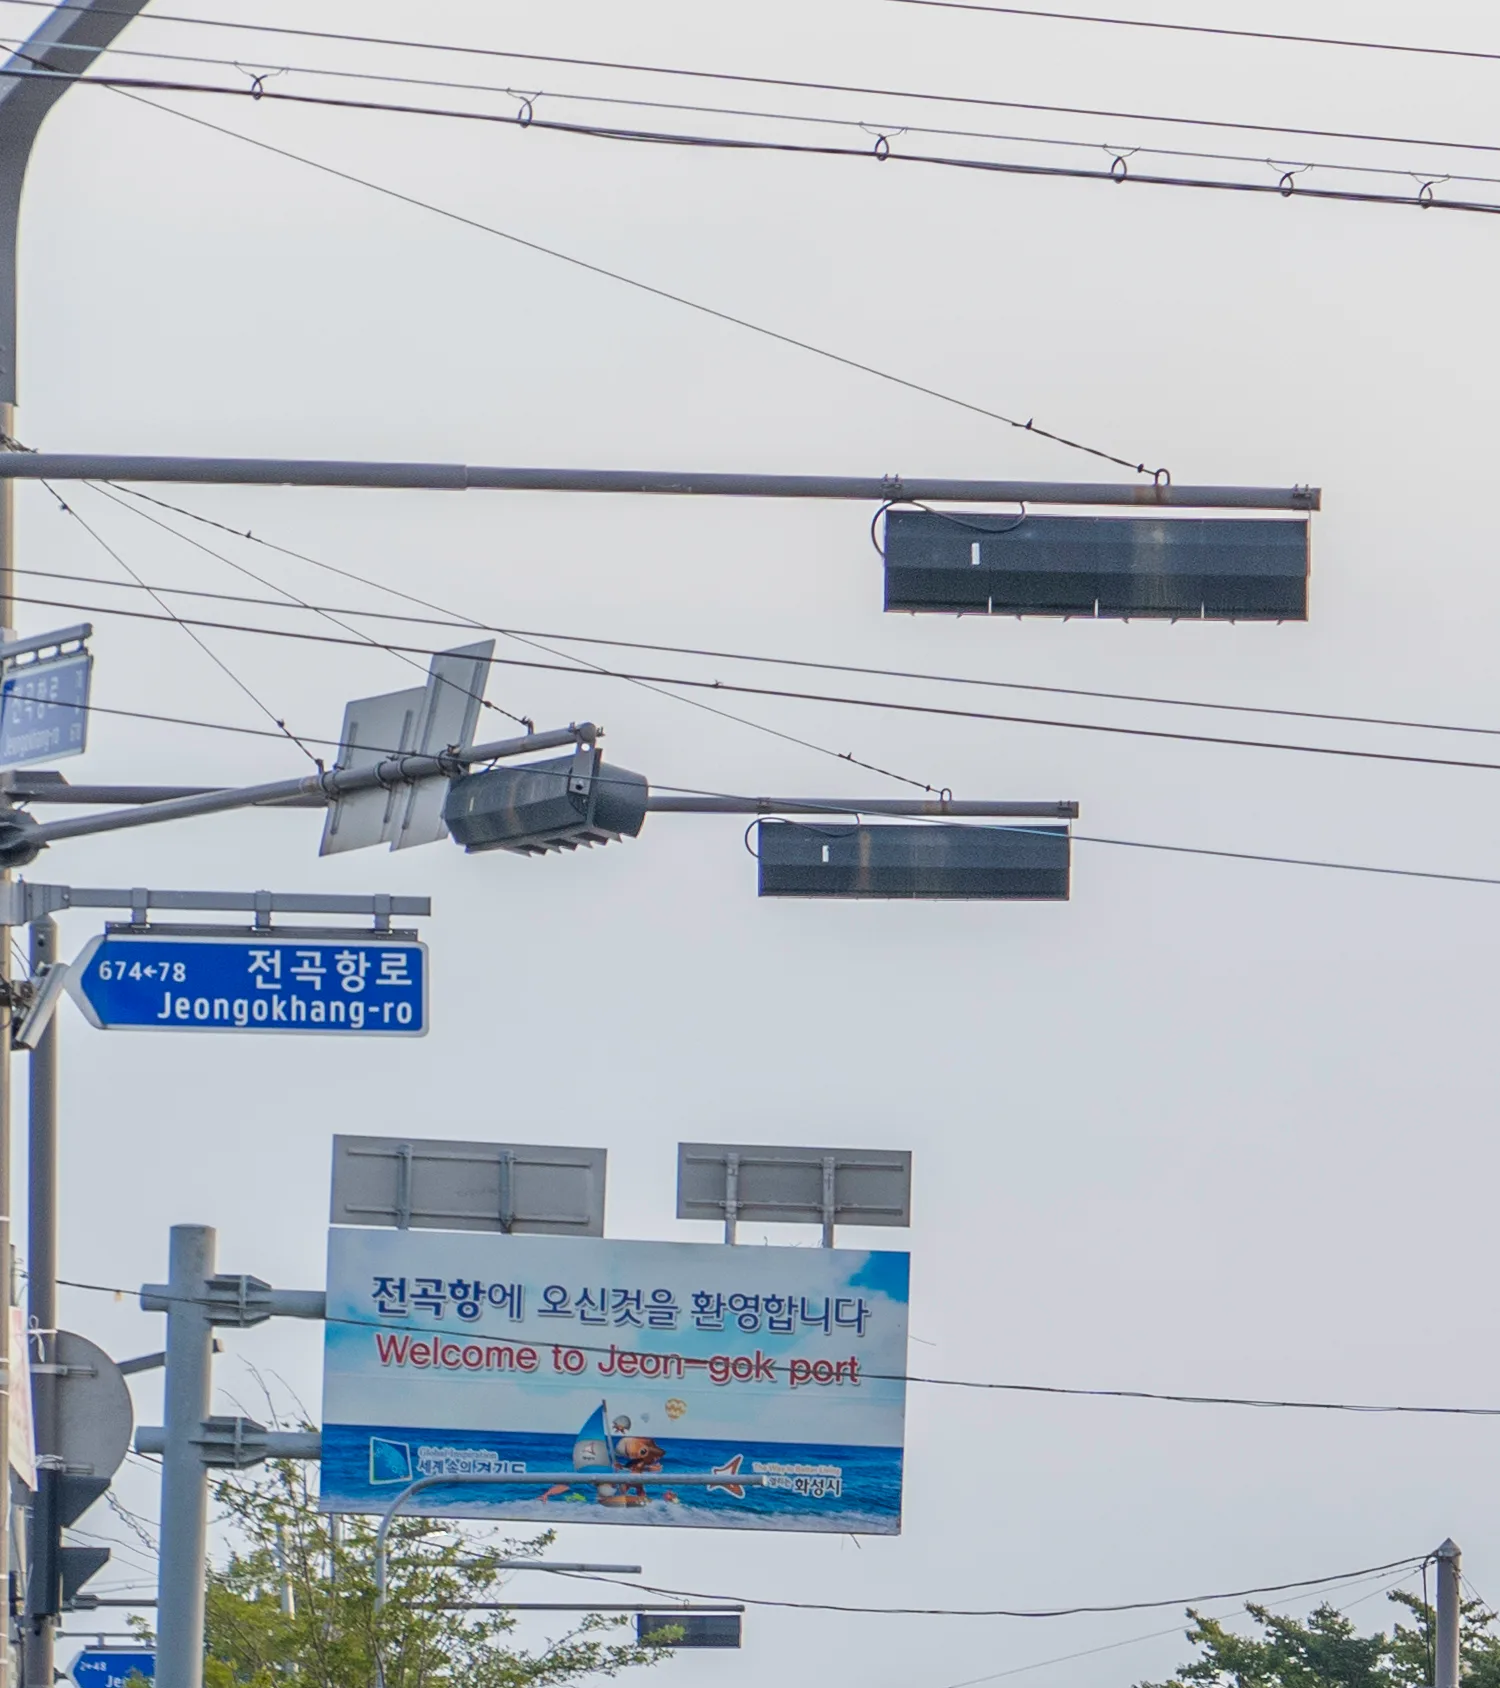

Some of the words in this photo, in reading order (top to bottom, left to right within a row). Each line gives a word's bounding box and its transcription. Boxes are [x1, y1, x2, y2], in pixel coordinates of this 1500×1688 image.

[99, 960, 142, 981] 674
[159, 961, 187, 983] 78
[247, 949, 413, 993] 전곡항로
[157, 991, 413, 1028] Jeongokhang-ro
[371, 1276, 523, 1320] 전곡항에
[537, 1284, 679, 1326] 오신것을
[690, 1290, 871, 1335] 환영합니다
[375, 1333, 538, 1371] Welcome
[552, 1344, 585, 1373] to
[598, 1343, 775, 1384] Jeon-gok
[789, 1355, 860, 1386] port
[794, 1478, 840, 1496] 화성시
